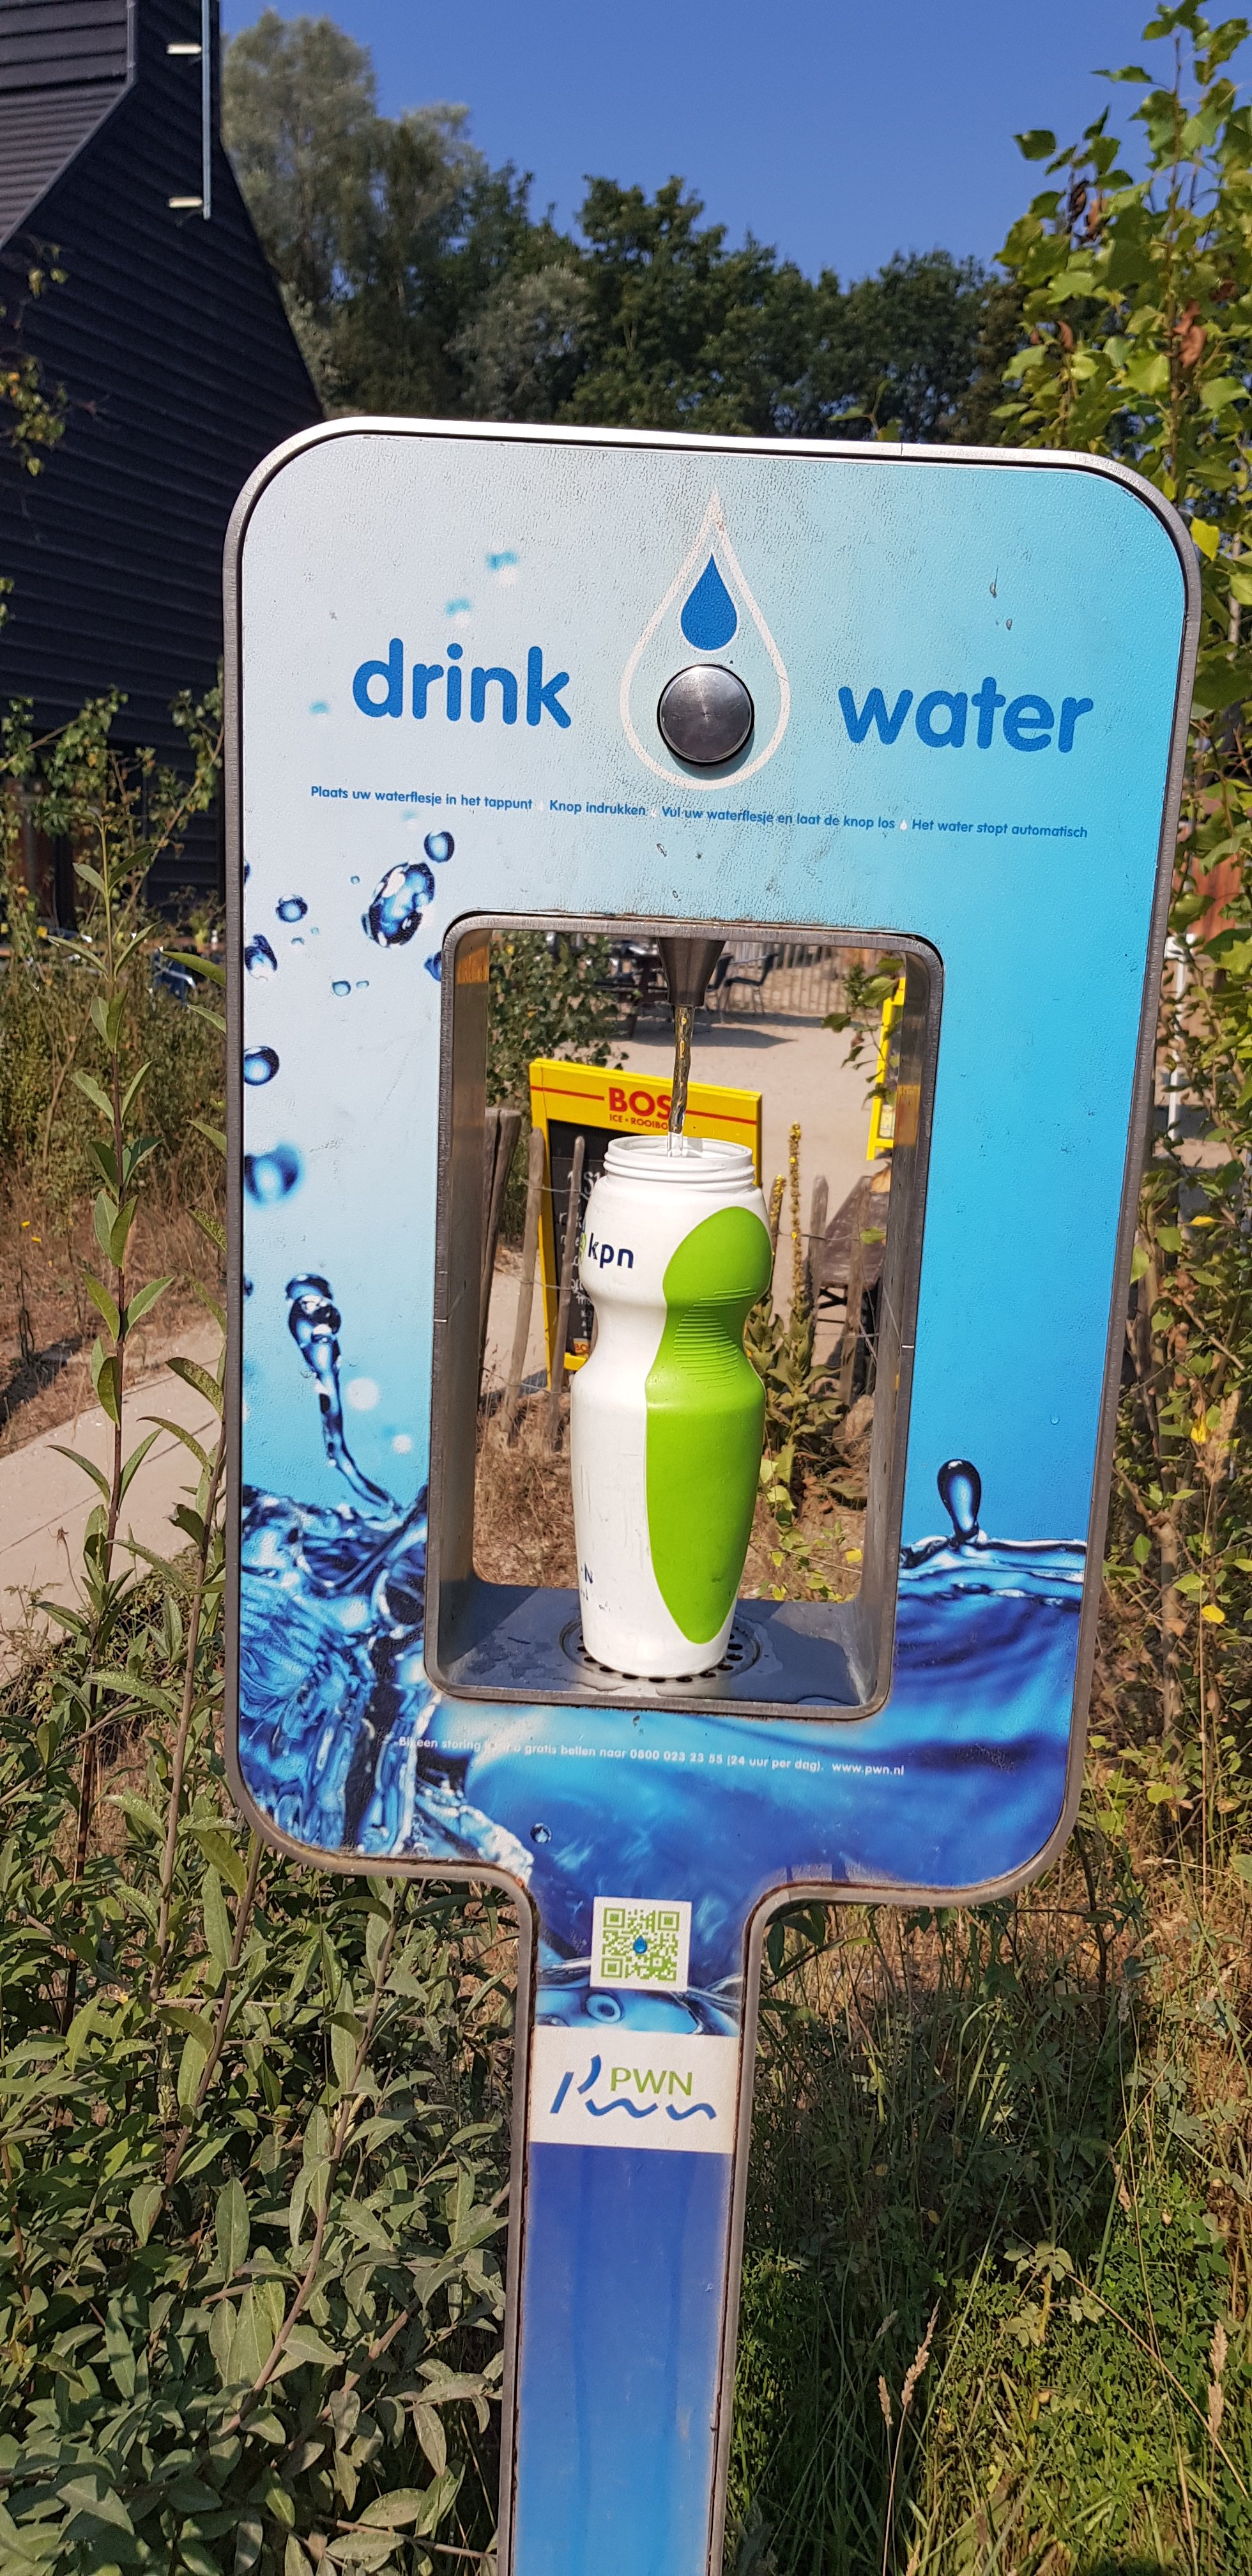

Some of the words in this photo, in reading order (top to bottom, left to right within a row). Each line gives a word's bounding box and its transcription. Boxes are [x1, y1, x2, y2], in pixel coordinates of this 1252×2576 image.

[353, 638, 572, 728] drink
[838, 677, 1094, 753] water
[311, 786, 348, 798] Plaats
[353, 791, 371, 799] uw
[375, 791, 442, 806] waterflesje
[446, 793, 457, 805] in
[461, 794, 480, 806] het
[485, 797, 533, 810] tappunt
[549, 799, 582, 814] Knop
[586, 801, 646, 816] indrukken
[662, 806, 681, 818] Vul
[685, 809, 703, 818] uw
[706, 809, 774, 824] waterflesje
[777, 815, 793, 825] en
[797, 813, 820, 825] laat
[824, 814, 840, 826] de
[843, 815, 874, 830] knop
[878, 816, 895, 829] los
[912, 819, 934, 830] Het
[938, 822, 974, 832] water
[976, 822, 1008, 836] stopt
[1011, 824, 1088, 838] automatisch
[609, 1087, 672, 1120] BOS
[609, 1114, 623, 1123] ICE
[630, 1117, 669, 1130] ROOIBO
[588, 1232, 634, 1269] kpn
[416, 1738, 438, 1749] een
[441, 1738, 482, 1752] storing
[524, 1744, 557, 1755] gratis
[560, 1745, 596, 1756] bellen
[599, 1748, 626, 1759] naar
[630, 1749, 660, 1761] 0800
[664, 1750, 686, 1762] 023
[689, 1752, 705, 1763] 23
[708, 1753, 723, 1764] 55
[727, 1754, 745, 1767] (24
[749, 1757, 768, 1767] uur
[772, 1759, 791, 1770] per
[795, 1758, 824, 1772] dag).
[832, 1762, 905, 1776] www.pwn.nl
[610, 2067, 693, 2097] PWN
